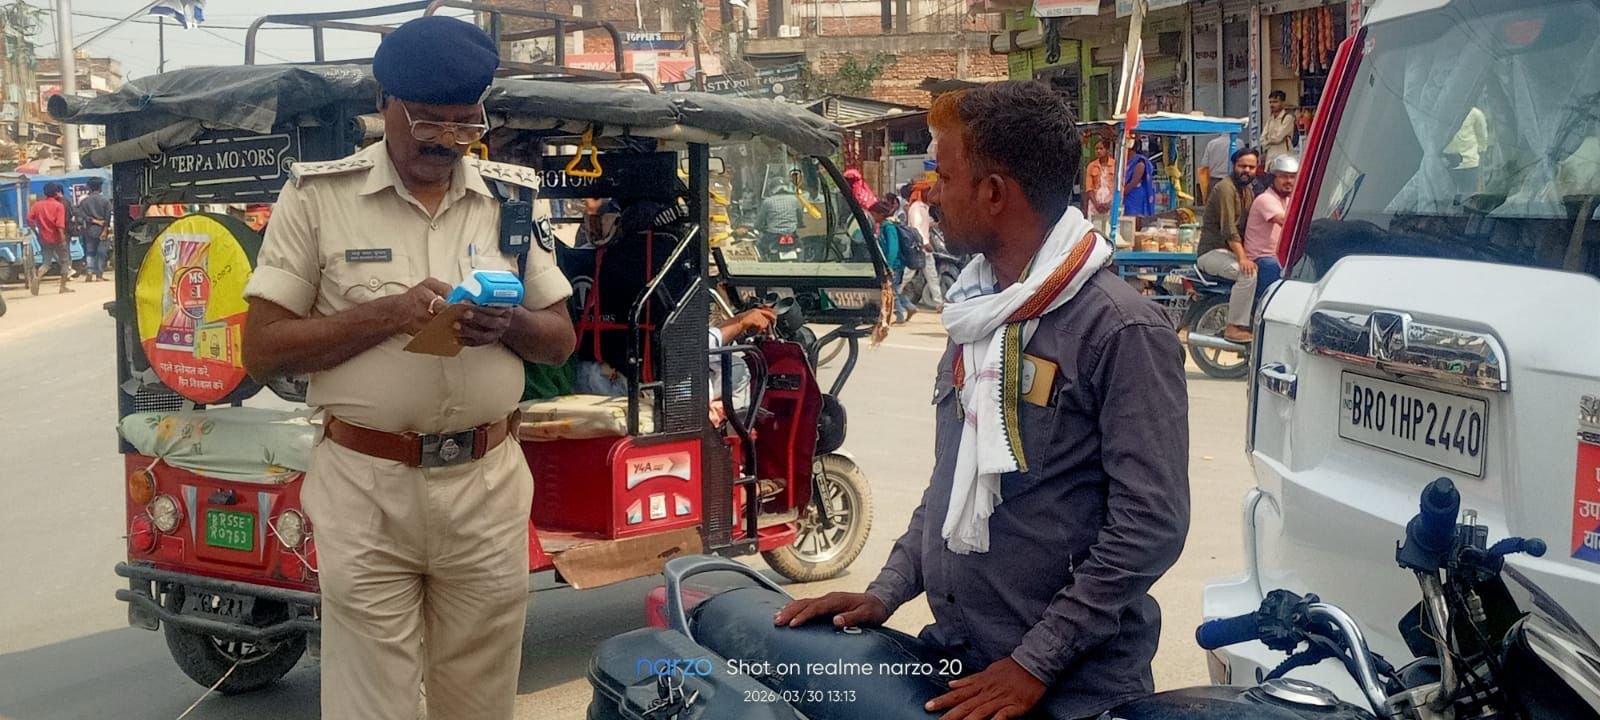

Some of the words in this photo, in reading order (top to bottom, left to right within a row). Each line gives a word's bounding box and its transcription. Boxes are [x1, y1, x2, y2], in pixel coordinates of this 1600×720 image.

[169, 154, 213, 173] TERRA
[216, 148, 275, 169] MOTORS
[189, 272, 203, 284] MS
[1352, 385, 1481, 458] BR01HP2440
